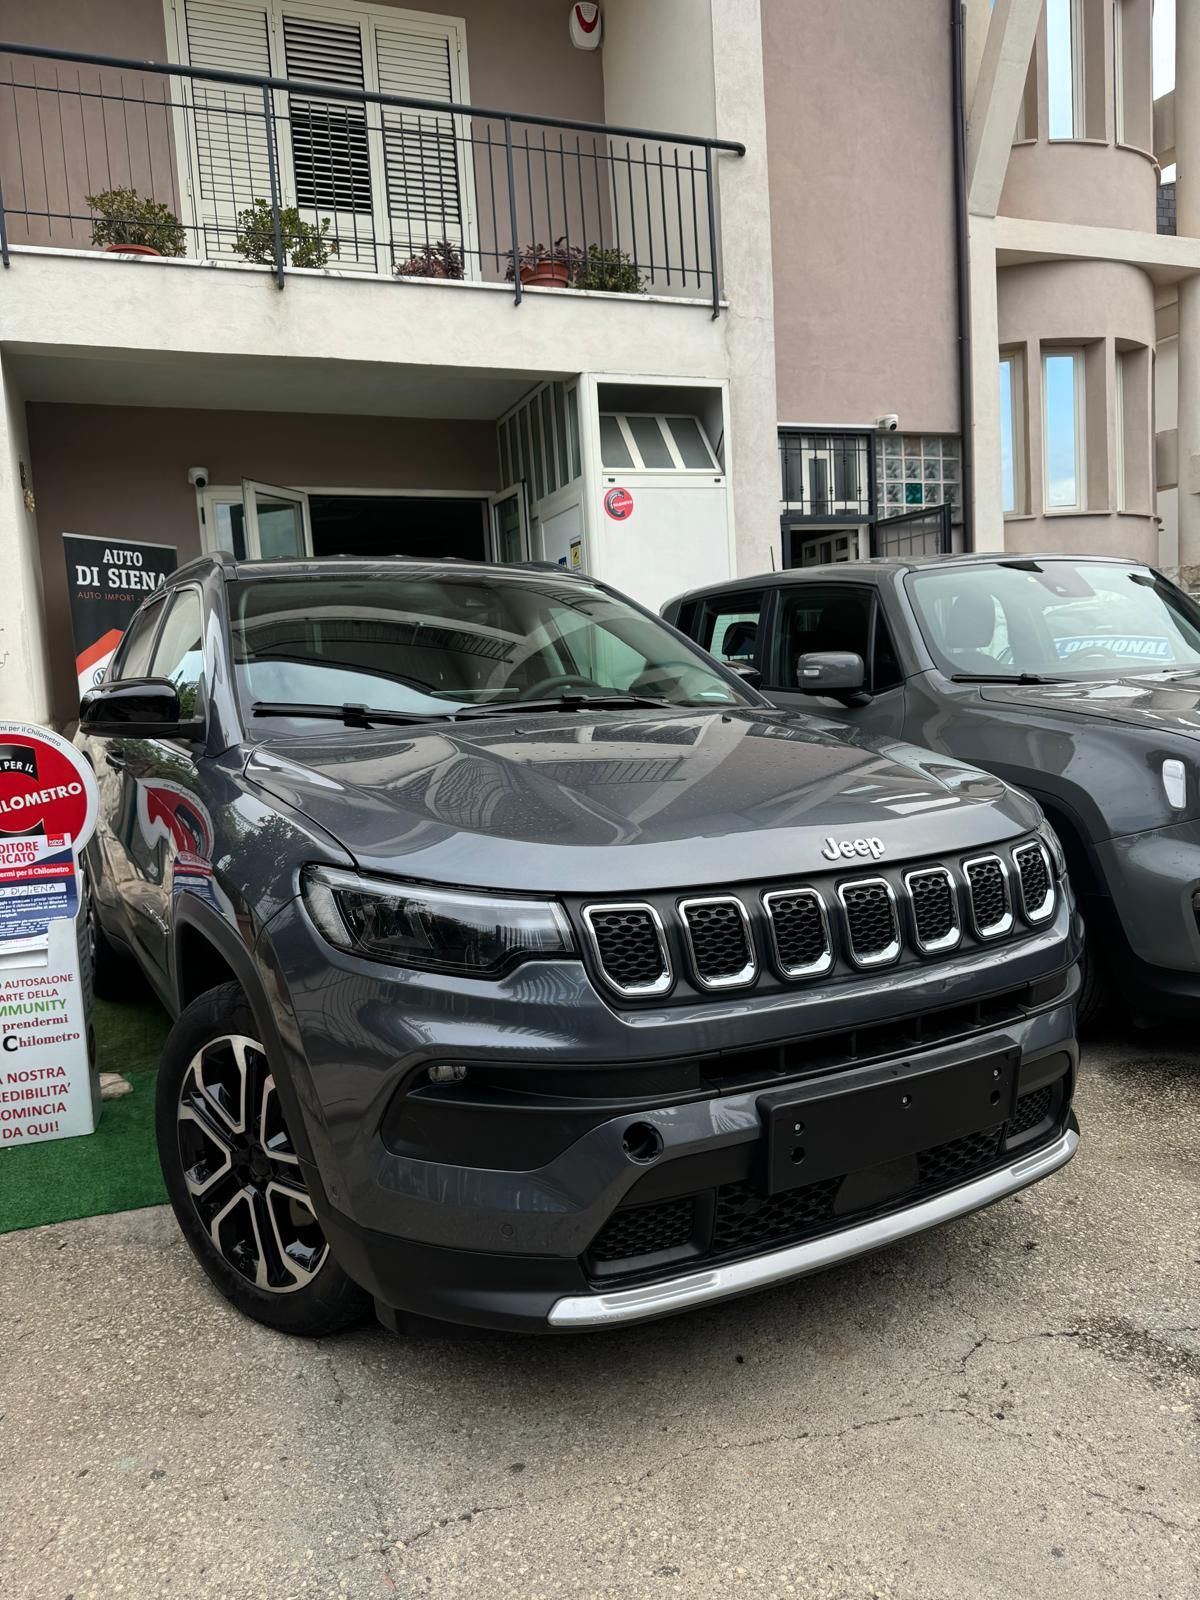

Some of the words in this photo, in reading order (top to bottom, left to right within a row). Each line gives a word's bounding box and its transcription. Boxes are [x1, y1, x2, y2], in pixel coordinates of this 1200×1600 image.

[102, 548, 143, 567] AUTO
[75, 565, 100, 587] DI
[77, 591, 101, 600] AUTO
[104, 592, 135, 602] IMPORT
[1064, 639, 1167, 655] OPTIONAL
[26, 727, 62, 747] Chilometro
[3, 761, 23, 770] PER
[25, 763, 34, 773] IL
[821, 837, 885, 860] Jeep
[16, 869, 27, 878] per
[33, 866, 70, 874] Chilometro
[4, 973, 74, 990] AUTOSALONE
[27, 988, 59, 1000] DELLA
[2, 1014, 69, 1034] prendermi
[2, 1032, 80, 1052] Chilometro
[7, 1066, 66, 1084] NOSTRA
[0, 1082, 71, 1103] EDIBILITA'
[0, 1102, 67, 1121] OMINCIA
[2, 1127, 23, 1139] DA
[27, 1120, 60, 1136] QUI!
